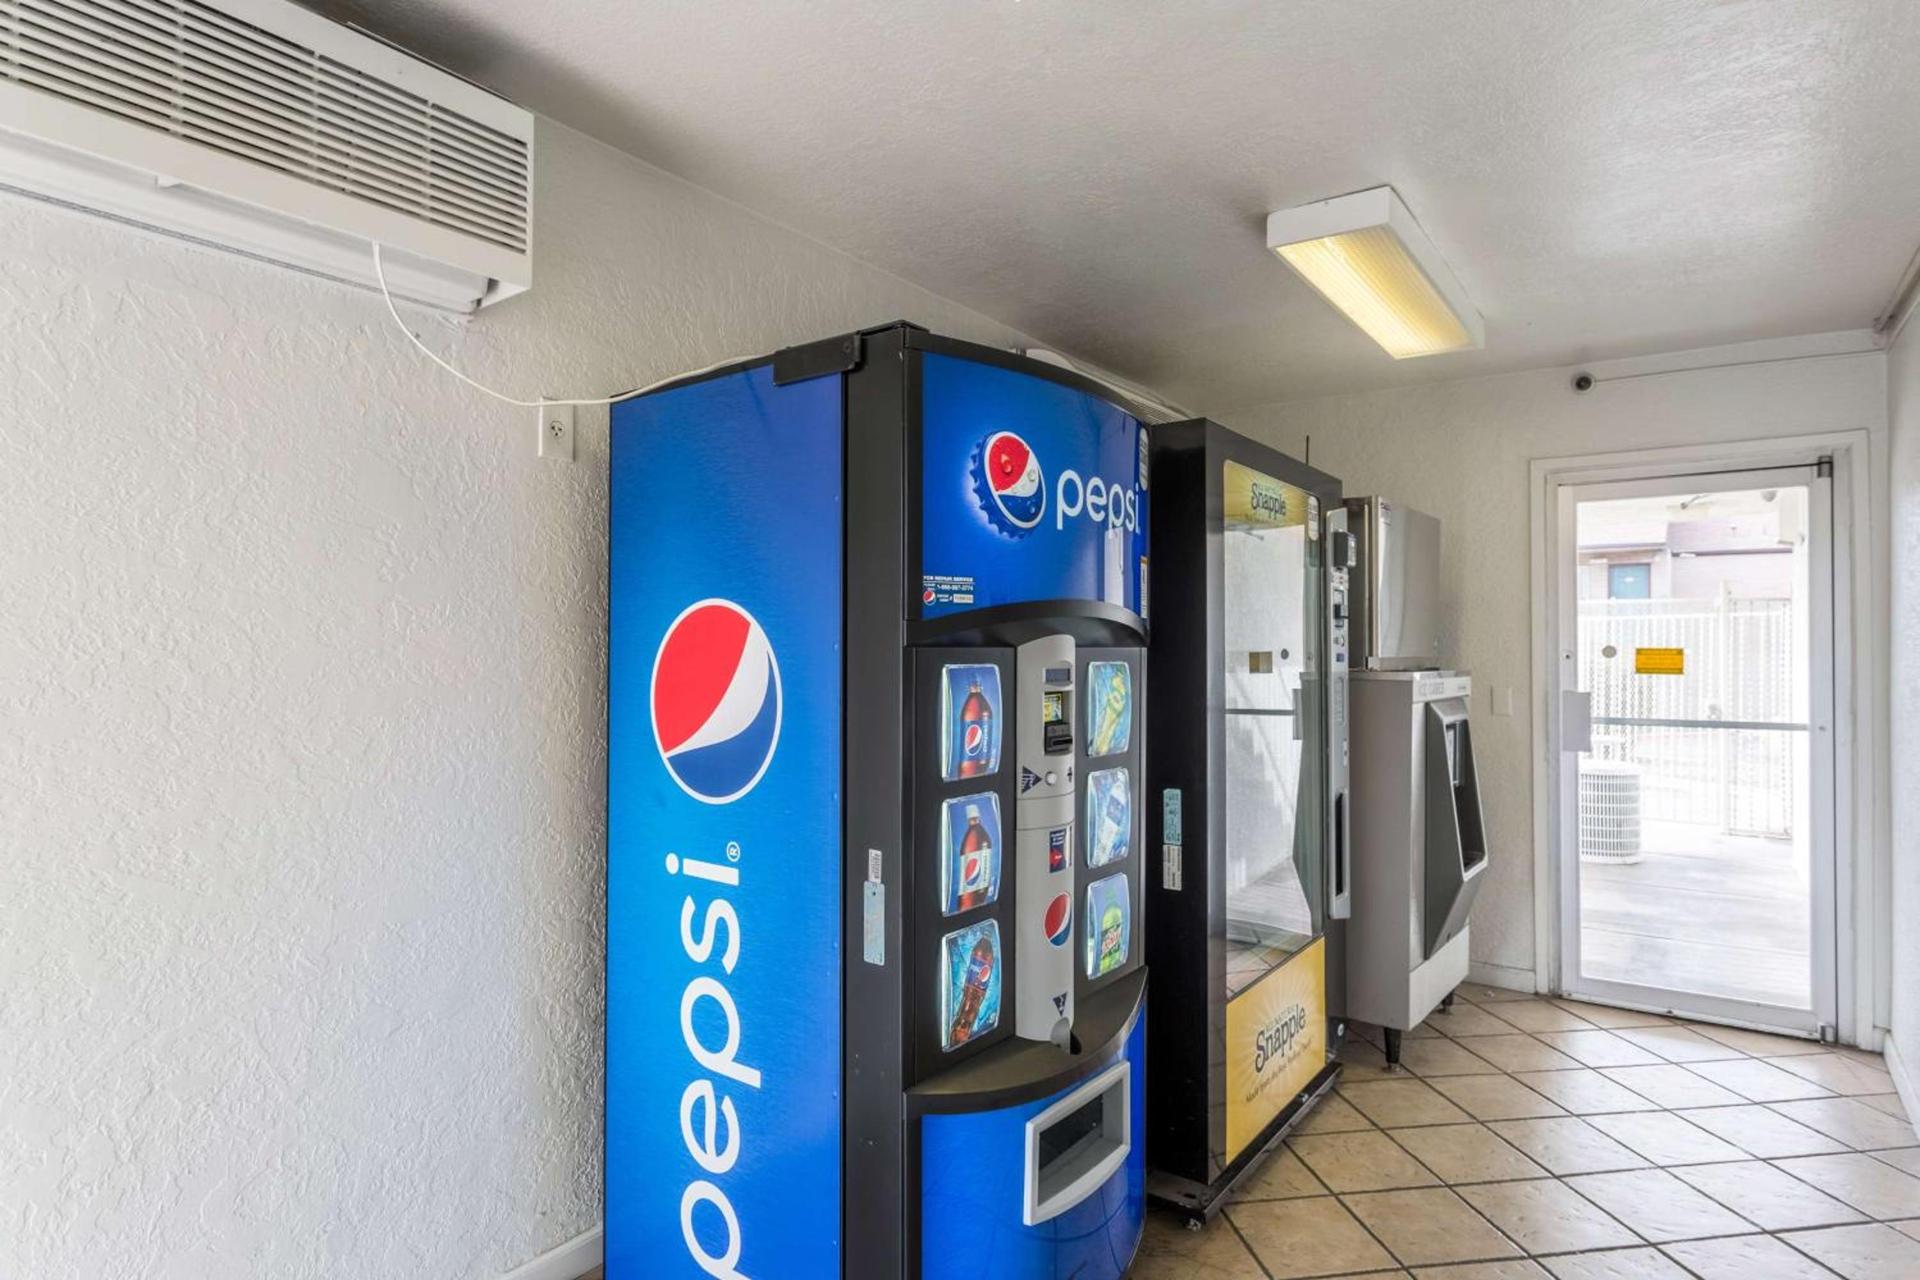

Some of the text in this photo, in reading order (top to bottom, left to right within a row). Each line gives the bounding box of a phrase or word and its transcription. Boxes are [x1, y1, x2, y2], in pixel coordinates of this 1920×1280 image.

[1056, 469, 1141, 537] pepsi
[1251, 482, 1287, 520] Snapple
[665, 853, 761, 1280] pepsi
[1255, 1003, 1306, 1073] Snapple
